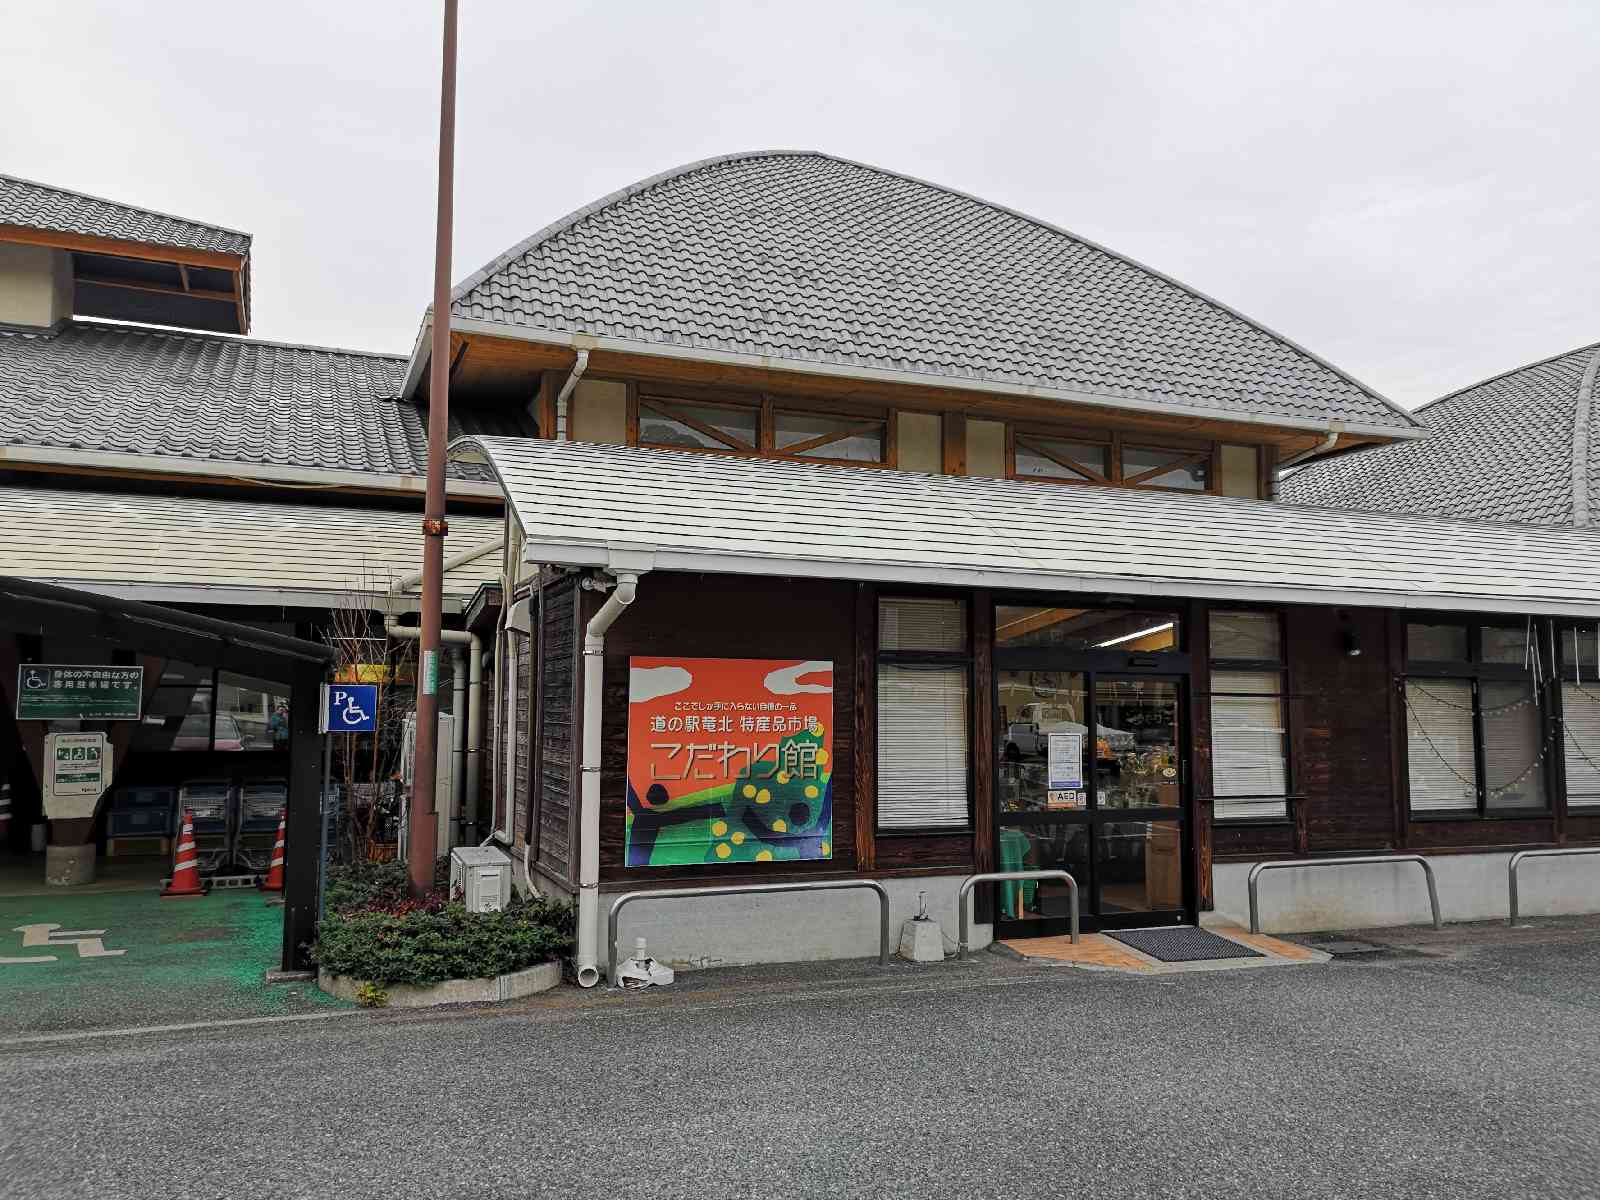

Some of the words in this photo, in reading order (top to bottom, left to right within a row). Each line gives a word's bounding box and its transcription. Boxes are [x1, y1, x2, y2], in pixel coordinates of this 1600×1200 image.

[334, 691, 347, 705] P
[650, 716, 734, 734] 道の駅竜北
[739, 715, 819, 734] 特産品市場
[650, 738, 818, 780] こだわり館
[1057, 792, 1075, 801] AED
